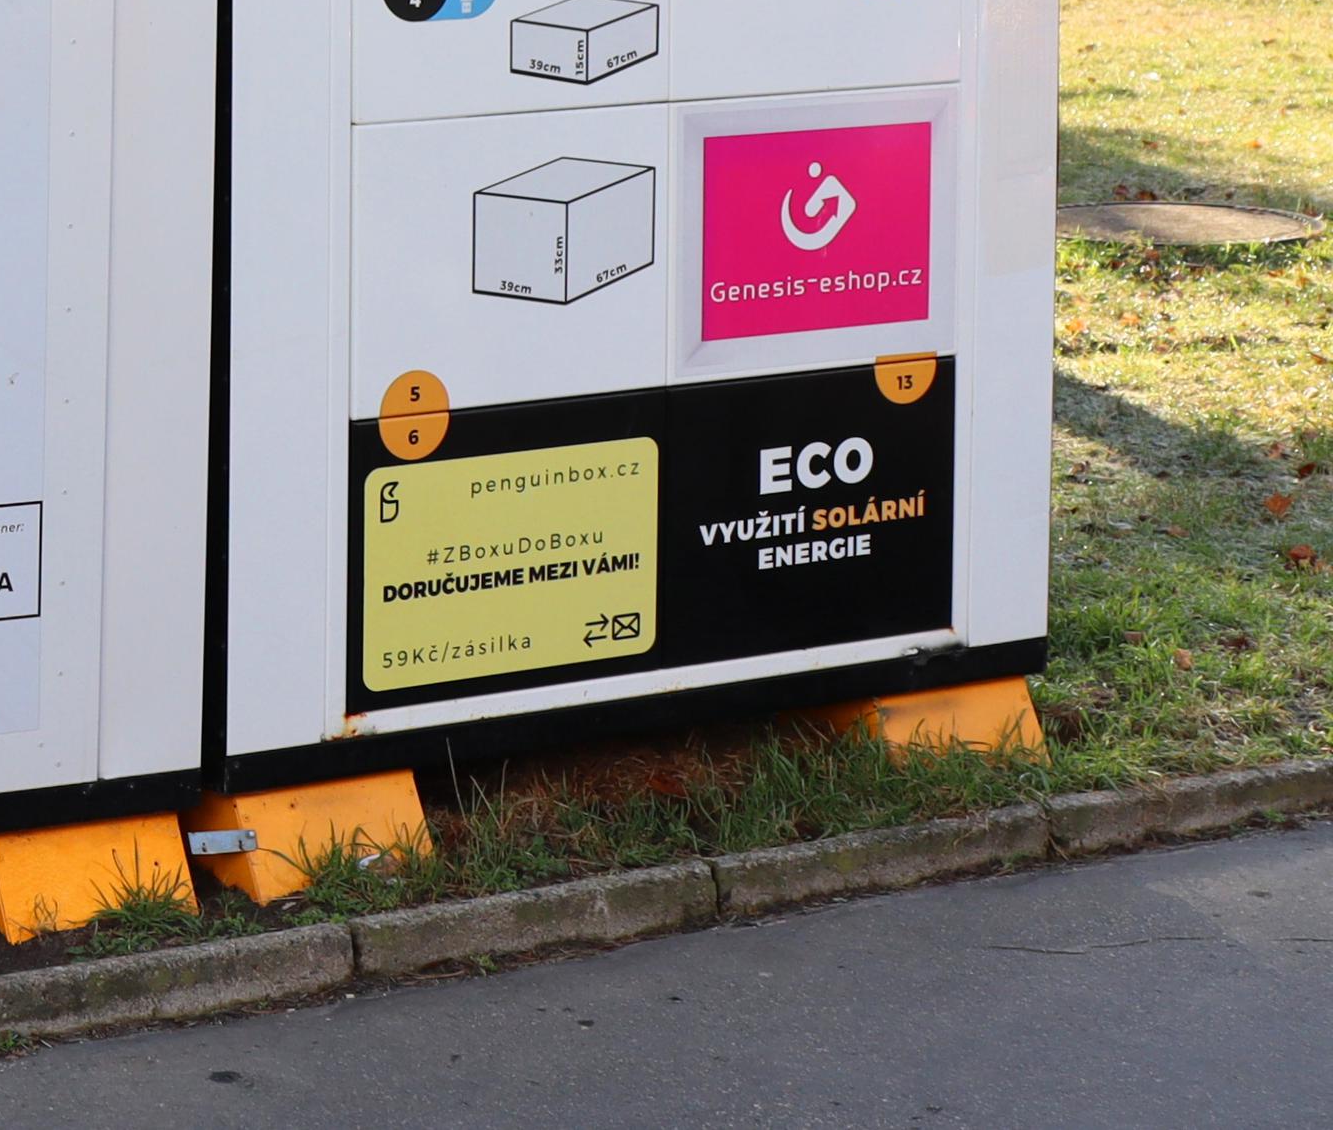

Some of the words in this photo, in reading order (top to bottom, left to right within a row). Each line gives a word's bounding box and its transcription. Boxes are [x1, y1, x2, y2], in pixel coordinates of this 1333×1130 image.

[529, 58, 561, 74] 39cm
[575, 39, 584, 75] 15cm
[606, 50, 638, 68] 67cm
[554, 236, 563, 274] 33cm
[500, 280, 532, 294] 39cm
[596, 264, 628, 283] 67cm
[710, 268, 923, 303] Genesis-eshop.cz
[410, 386, 421, 402] 5
[897, 375, 913, 390] 13
[408, 430, 419, 445] 6
[470, 462, 640, 499] penguinbox.cz
[759, 436, 874, 495] ECO
[699, 505, 806, 546] VYUŽITÍ
[811, 489, 926, 532] SOLÁRNÍ
[427, 530, 604, 565] #ZBoxuDoBoxu
[758, 534, 871, 570] ENERGIE
[383, 568, 524, 603] DORUČUJEME
[529, 561, 577, 583] MEZI
[582, 552, 640, 576] VÁMI!
[383, 635, 532, 669] 59Kč/zásilka
